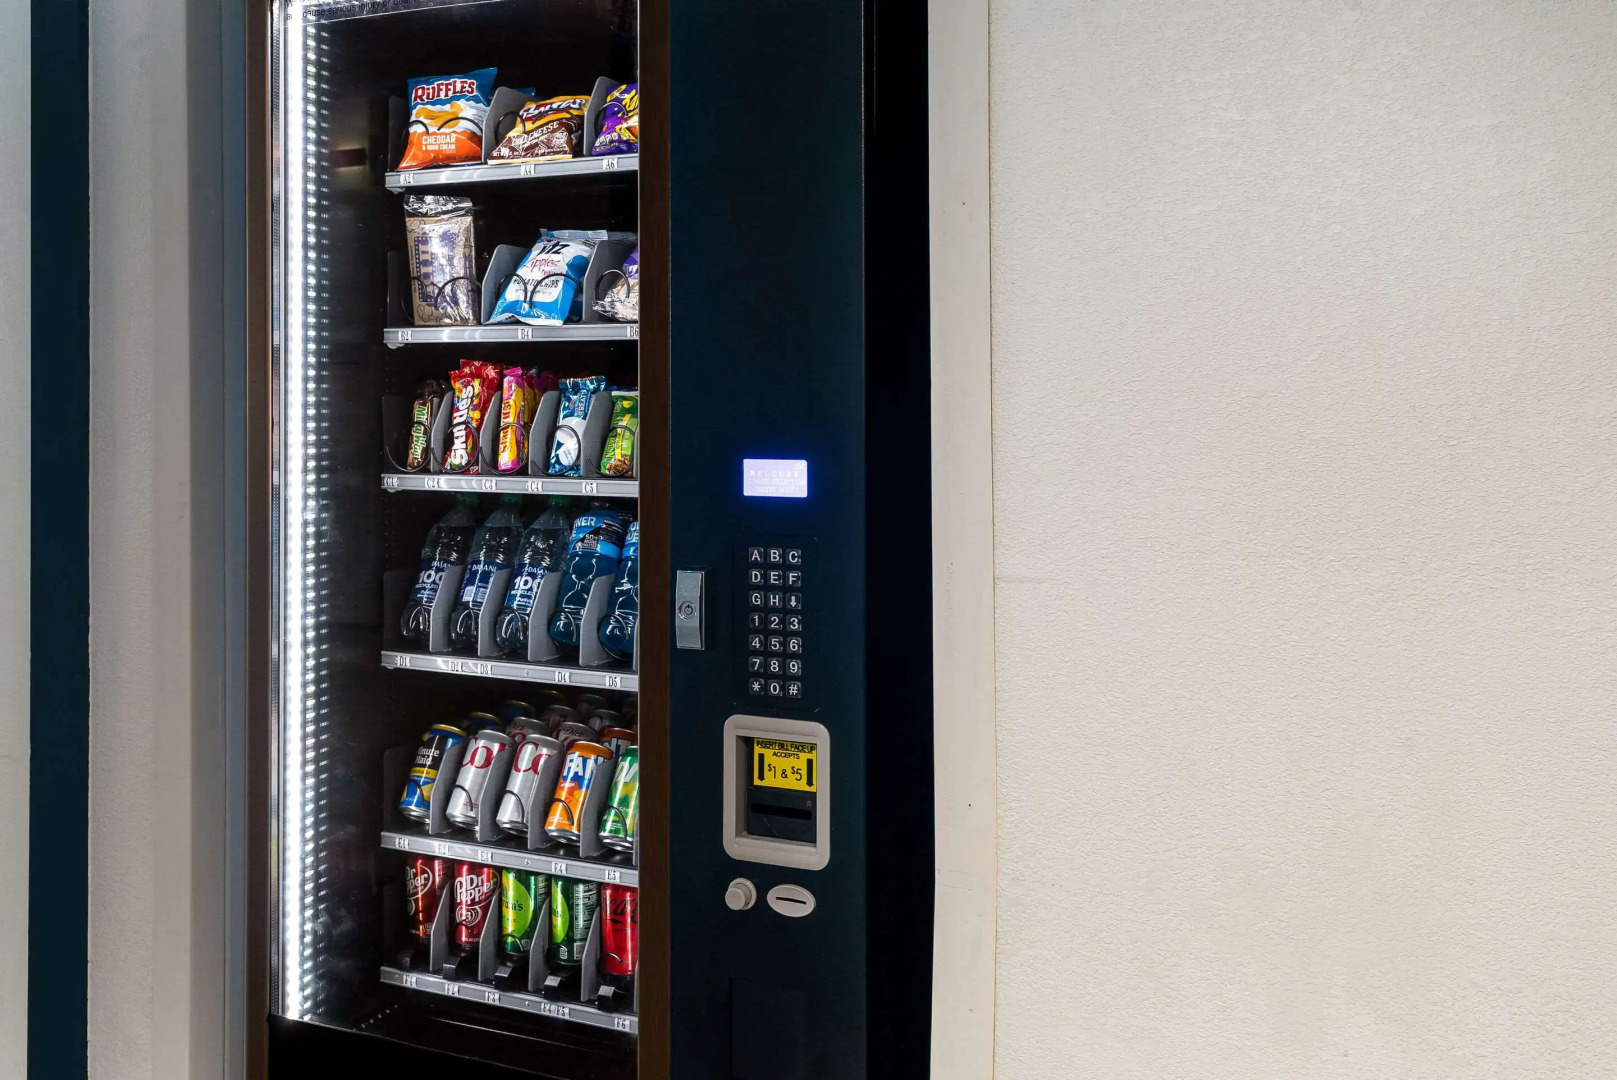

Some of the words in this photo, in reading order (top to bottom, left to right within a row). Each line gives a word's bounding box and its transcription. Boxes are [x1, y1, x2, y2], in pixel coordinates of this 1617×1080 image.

[412, 80, 476, 103] RUFFLES
[529, 121, 559, 140] CHEESE
[422, 133, 456, 144] CHEDDAR
[440, 143, 456, 151] CREAM
[605, 158, 615, 170] A6
[521, 329, 530, 340] B4
[386, 477, 395, 487] C1
[426, 478, 436, 488] C2
[530, 482, 540, 492] C4
[584, 483, 594, 494] C5
[752, 551, 760, 561] A
[770, 551, 779, 561] B
[789, 551, 798, 562] C
[752, 571, 760, 582] D
[771, 573, 779, 584] E
[789, 574, 798, 585] F
[752, 593, 761, 605] G
[770, 595, 779, 606] H
[753, 616, 759, 626] 1
[771, 617, 779, 628] 2
[790, 618, 798, 629] 3
[752, 638, 761, 648] 4
[771, 639, 779, 650] 5
[790, 640, 798, 651] 6
[399, 657, 408, 667] D1
[752, 659, 760, 670] 7
[770, 661, 779, 672] 8
[790, 662, 798, 673] 9
[480, 664, 489, 675] D3
[558, 671, 567, 683] D4
[608, 676, 618, 687] D5
[789, 684, 798, 695] #
[756, 740, 778, 750] INSERT
[778, 742, 790, 751] BILL
[791, 743, 806, 753] FACE
[806, 745, 815, 753] UP
[772, 751, 800, 760] ACCEPTS
[768, 763, 776, 779] $1
[781, 769, 788, 778] &
[791, 766, 802, 781] $5
[487, 991, 496, 1002] F3
[556, 1006, 566, 1017] F5
[616, 1018, 626, 1030] F6
